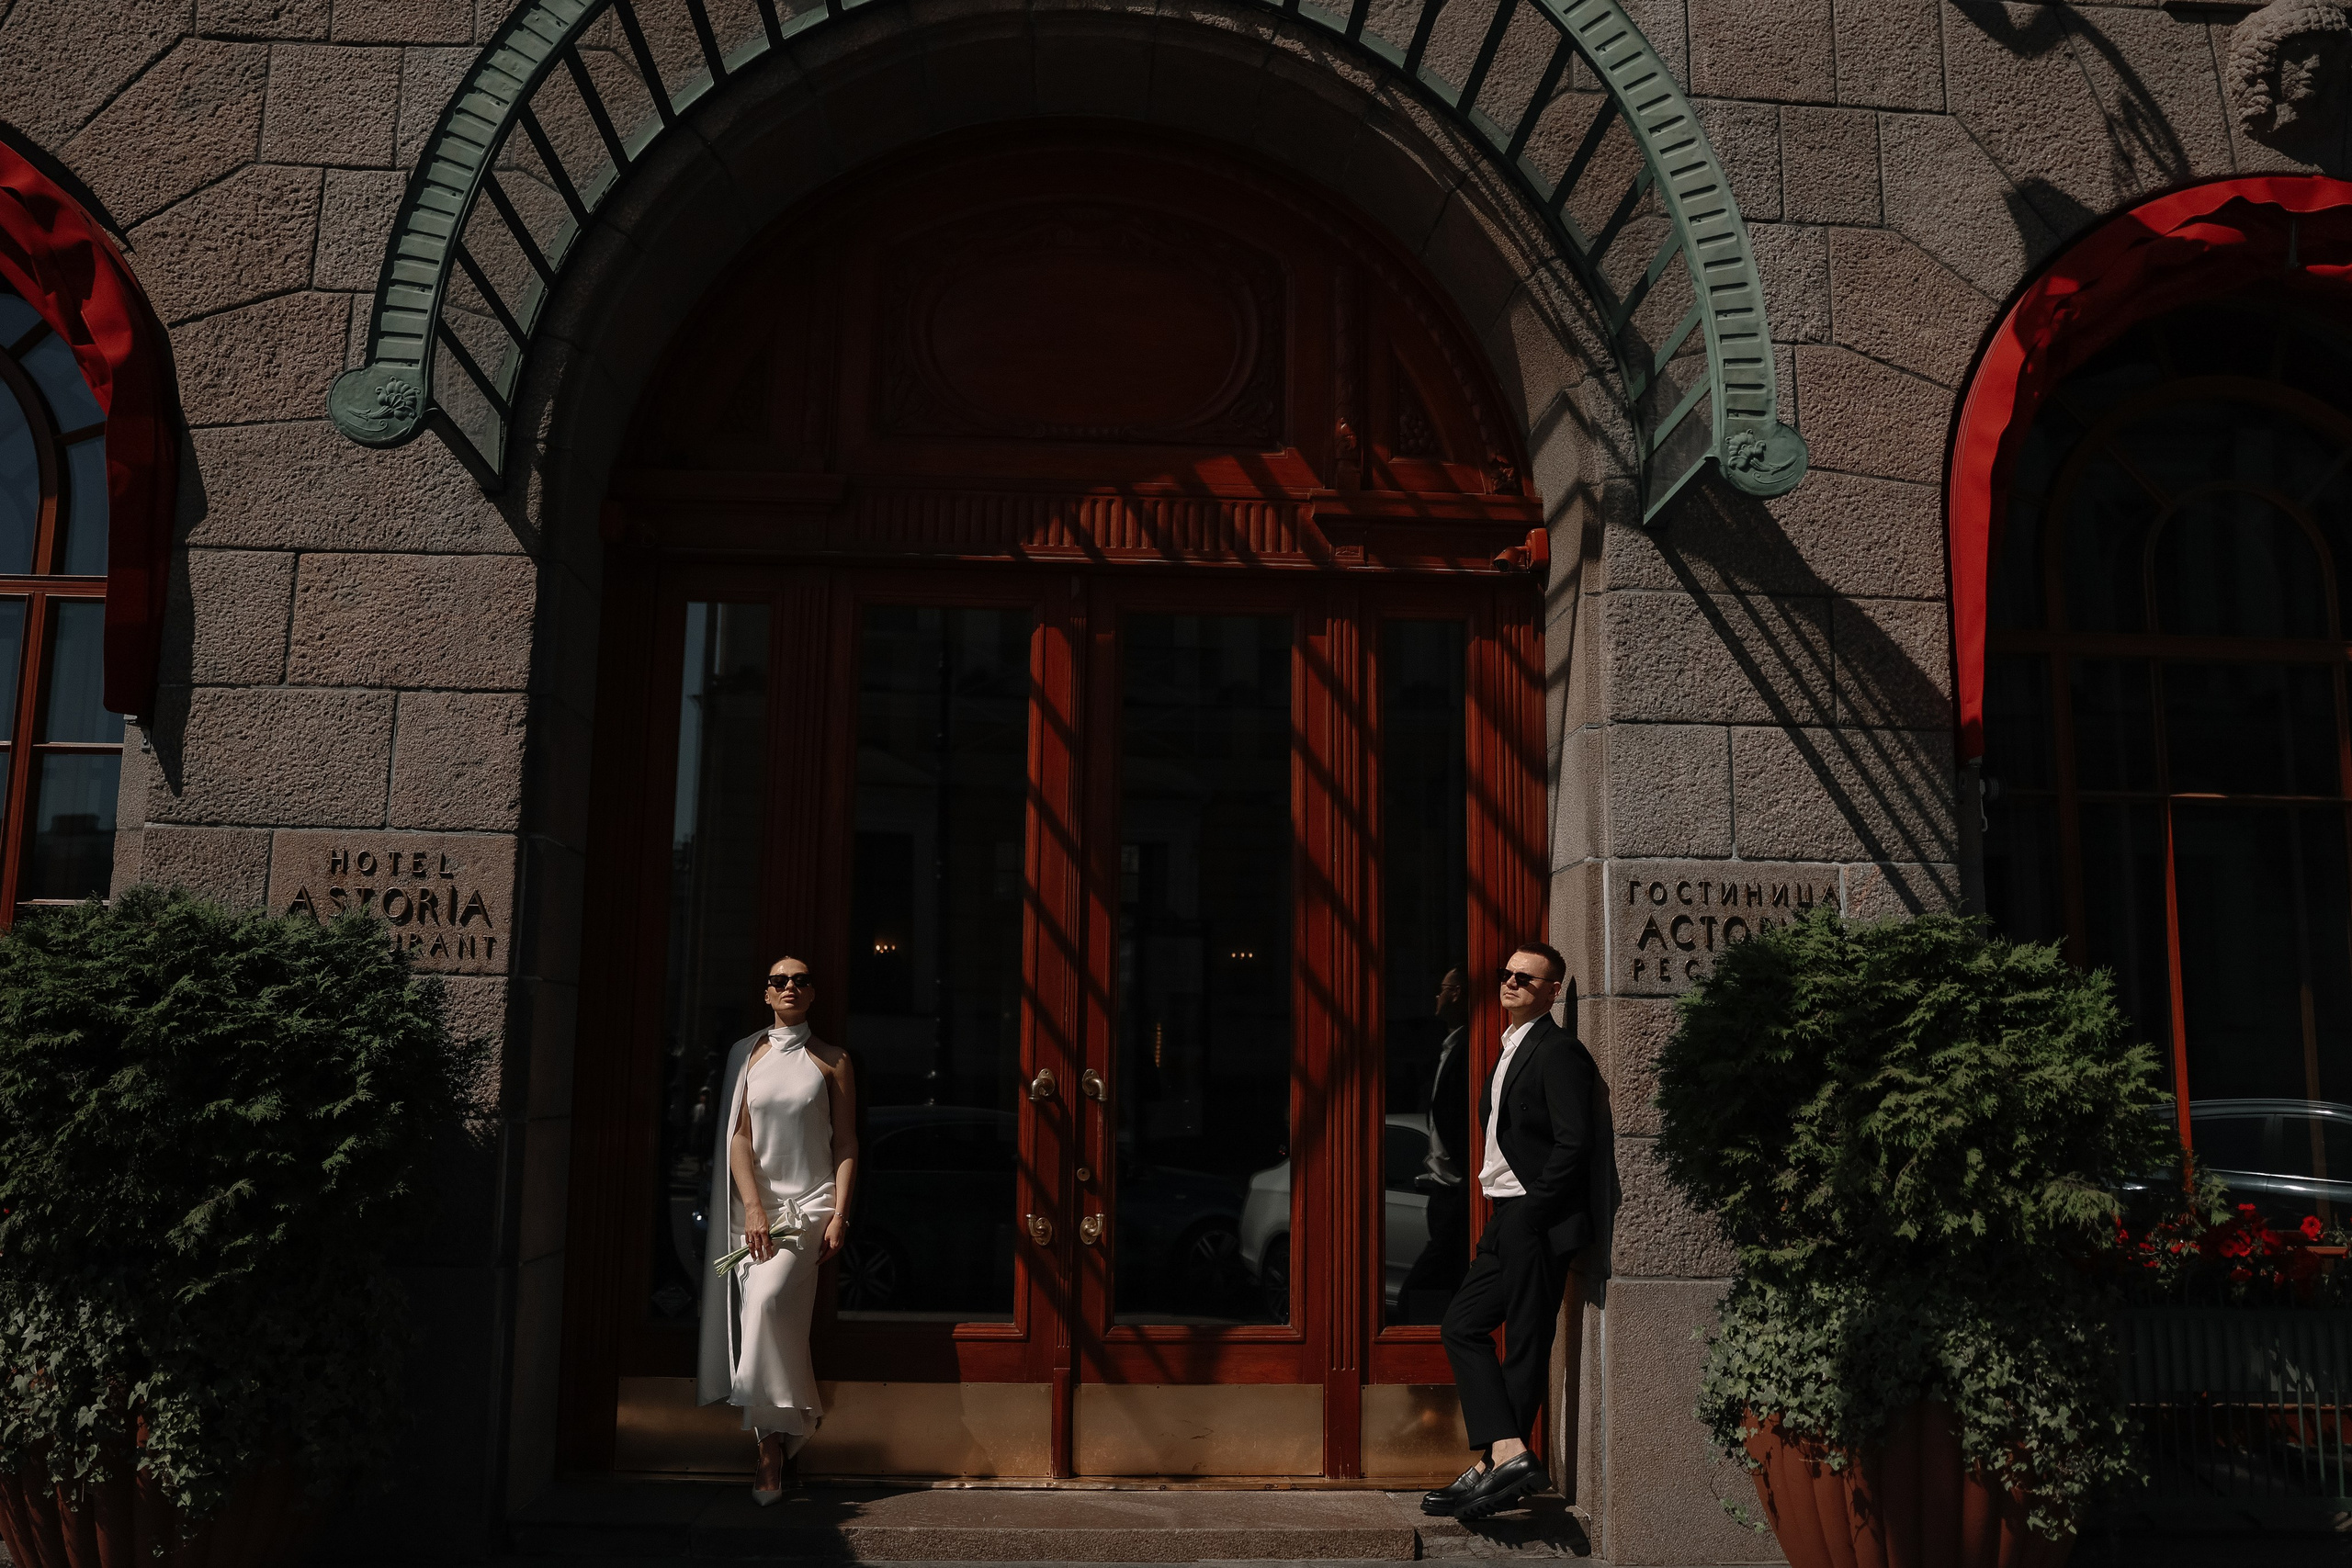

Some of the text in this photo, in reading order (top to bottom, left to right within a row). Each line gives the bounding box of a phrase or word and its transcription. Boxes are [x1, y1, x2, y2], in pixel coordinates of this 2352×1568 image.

[330, 848, 454, 879] HOTEL
[288, 884, 492, 928] ASTORIA
[1628, 880, 1839, 909] ГОСТИНИЦА
